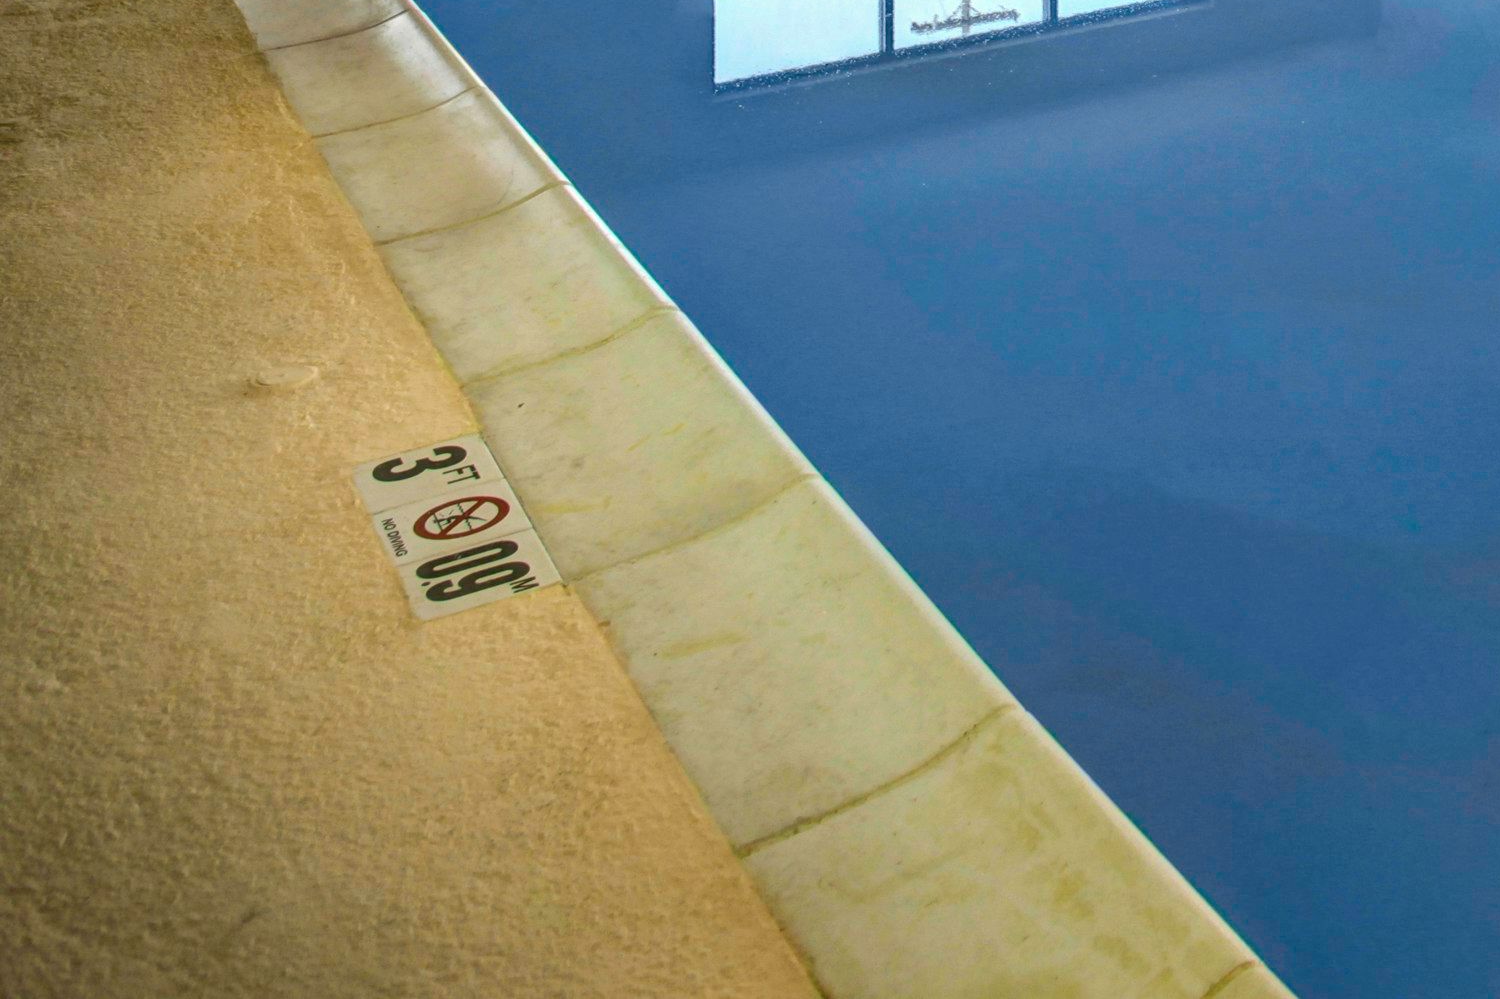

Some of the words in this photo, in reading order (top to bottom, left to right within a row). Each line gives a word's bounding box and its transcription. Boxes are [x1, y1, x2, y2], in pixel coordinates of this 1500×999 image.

[372, 445, 467, 482] 3
[442, 463, 481, 484] FT
[381, 517, 397, 531] NO
[387, 530, 408, 557] DIVING
